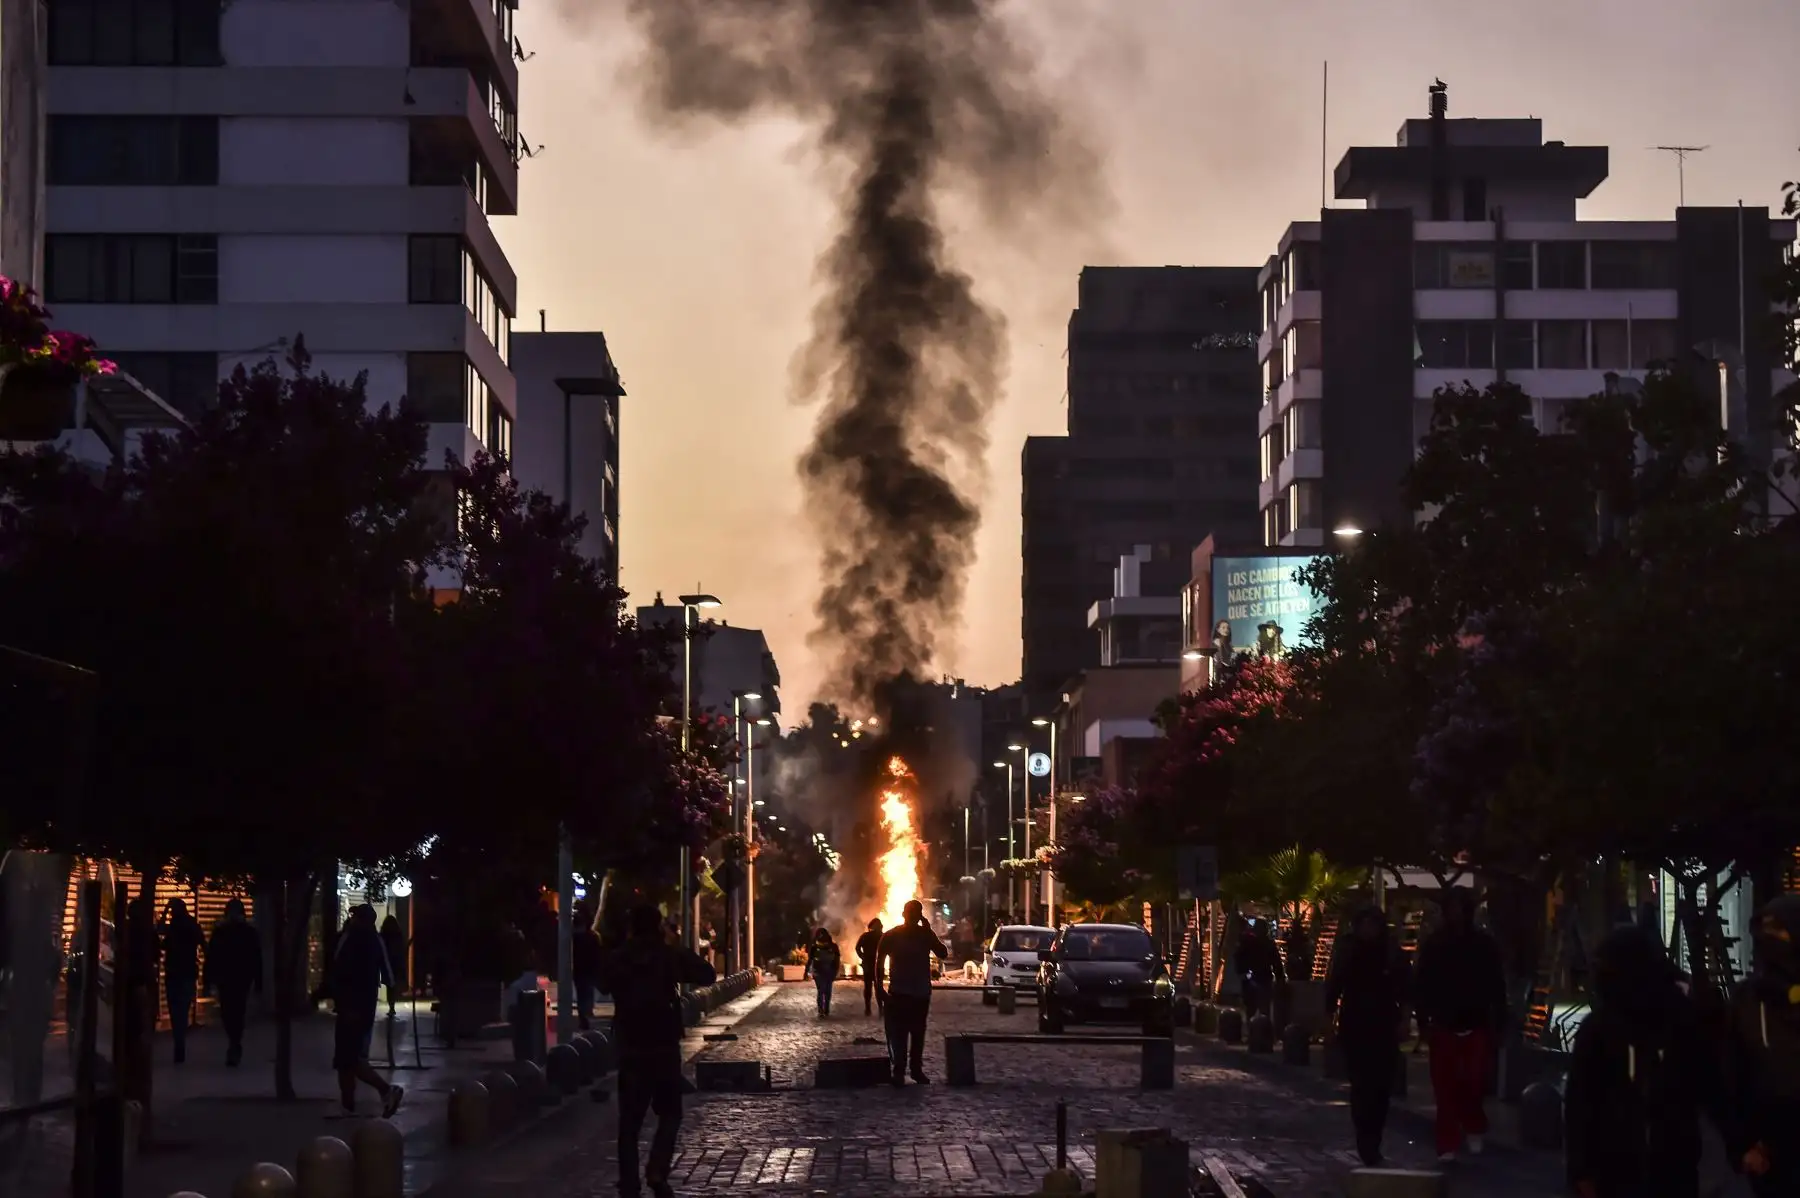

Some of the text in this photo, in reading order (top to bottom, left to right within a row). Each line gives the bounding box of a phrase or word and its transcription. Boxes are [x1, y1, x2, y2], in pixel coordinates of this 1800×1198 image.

[1228, 571, 1247, 586] LOS
[1228, 586, 1261, 603] NACEN
[1263, 584, 1277, 598] DE
[1228, 604, 1249, 620] QUE
[1250, 602, 1263, 617] SE
